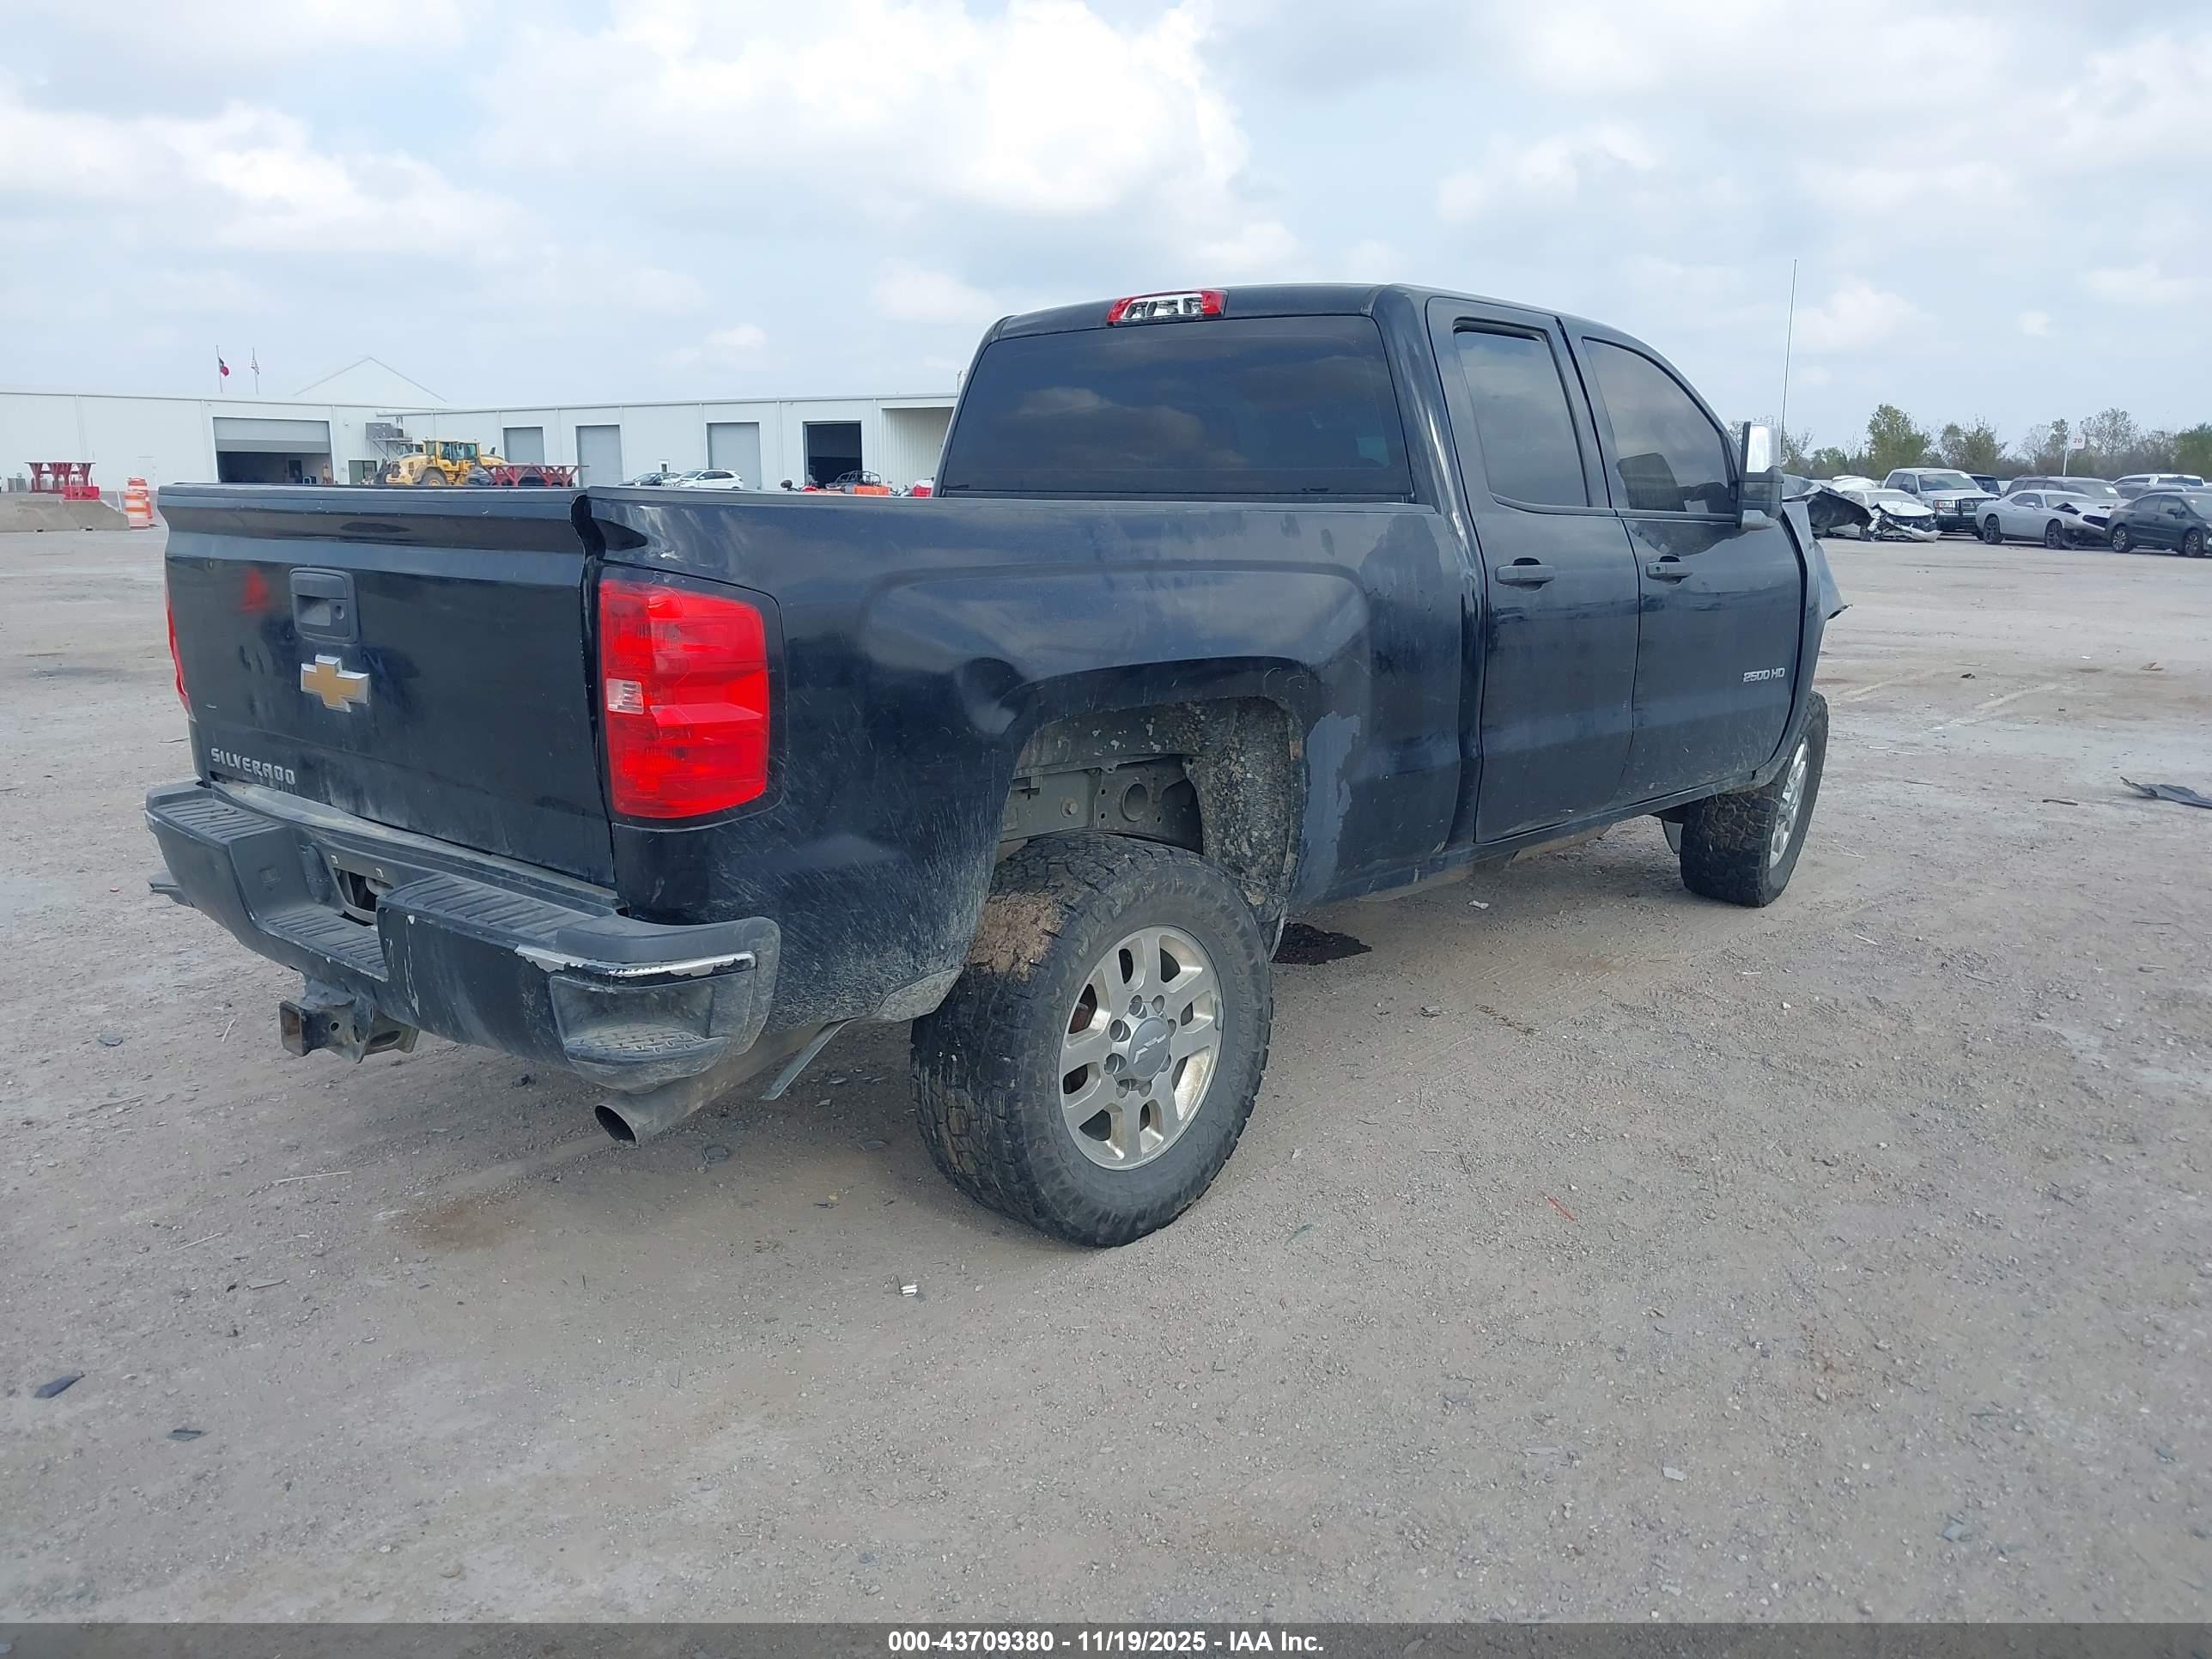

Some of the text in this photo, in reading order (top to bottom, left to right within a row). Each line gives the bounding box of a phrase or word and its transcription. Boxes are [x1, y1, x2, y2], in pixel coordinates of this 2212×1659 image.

[1743, 667, 1785, 683] 2500 HD
[210, 747, 296, 786] SILVERADO
